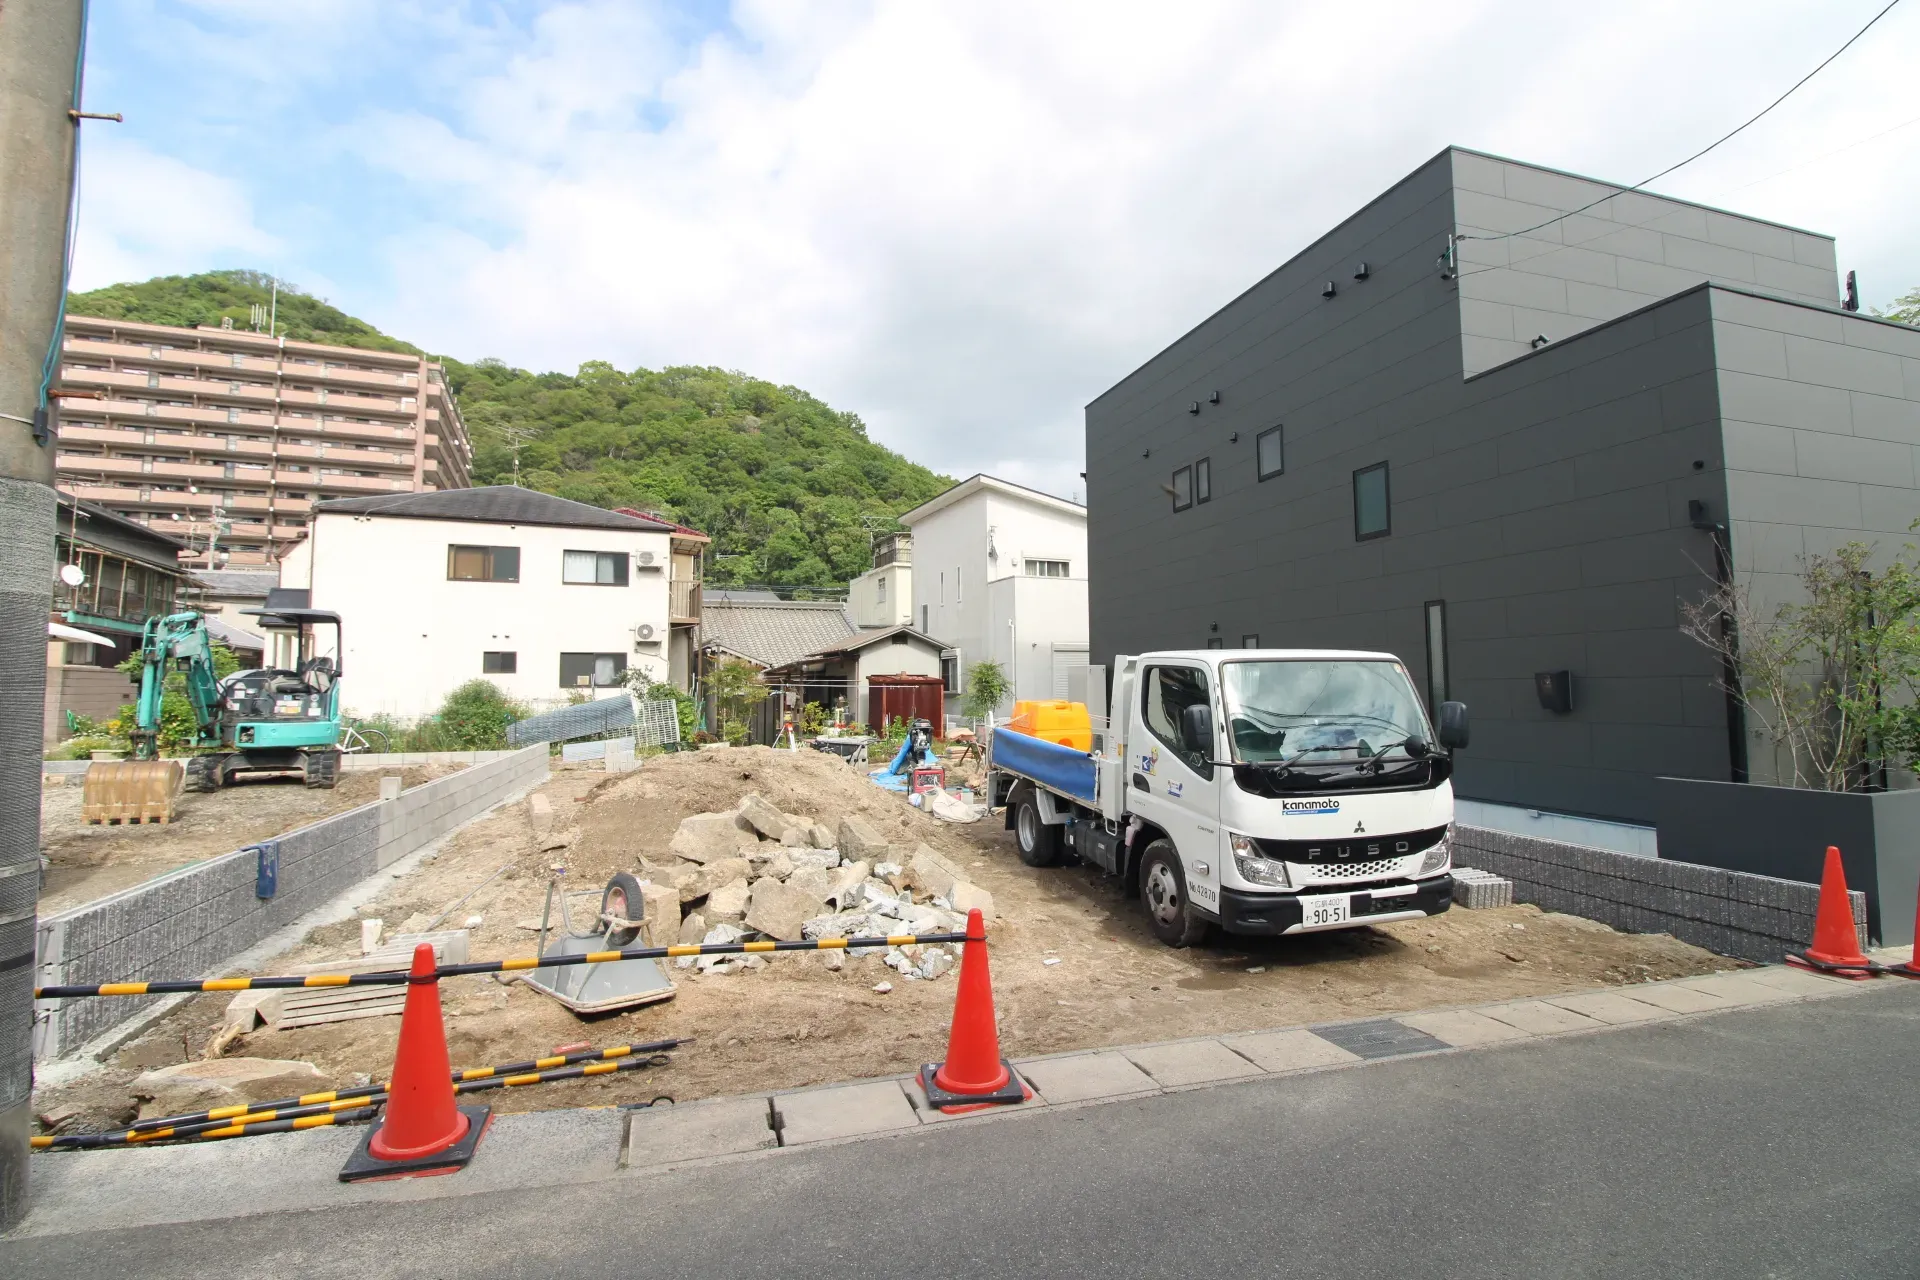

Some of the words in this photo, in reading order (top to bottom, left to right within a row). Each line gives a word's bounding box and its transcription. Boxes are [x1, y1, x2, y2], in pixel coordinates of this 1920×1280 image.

[1282, 798, 1340, 810] kanamoto
[1308, 841, 1409, 860] FUSO
[1313, 906, 1346, 924] 90-51
